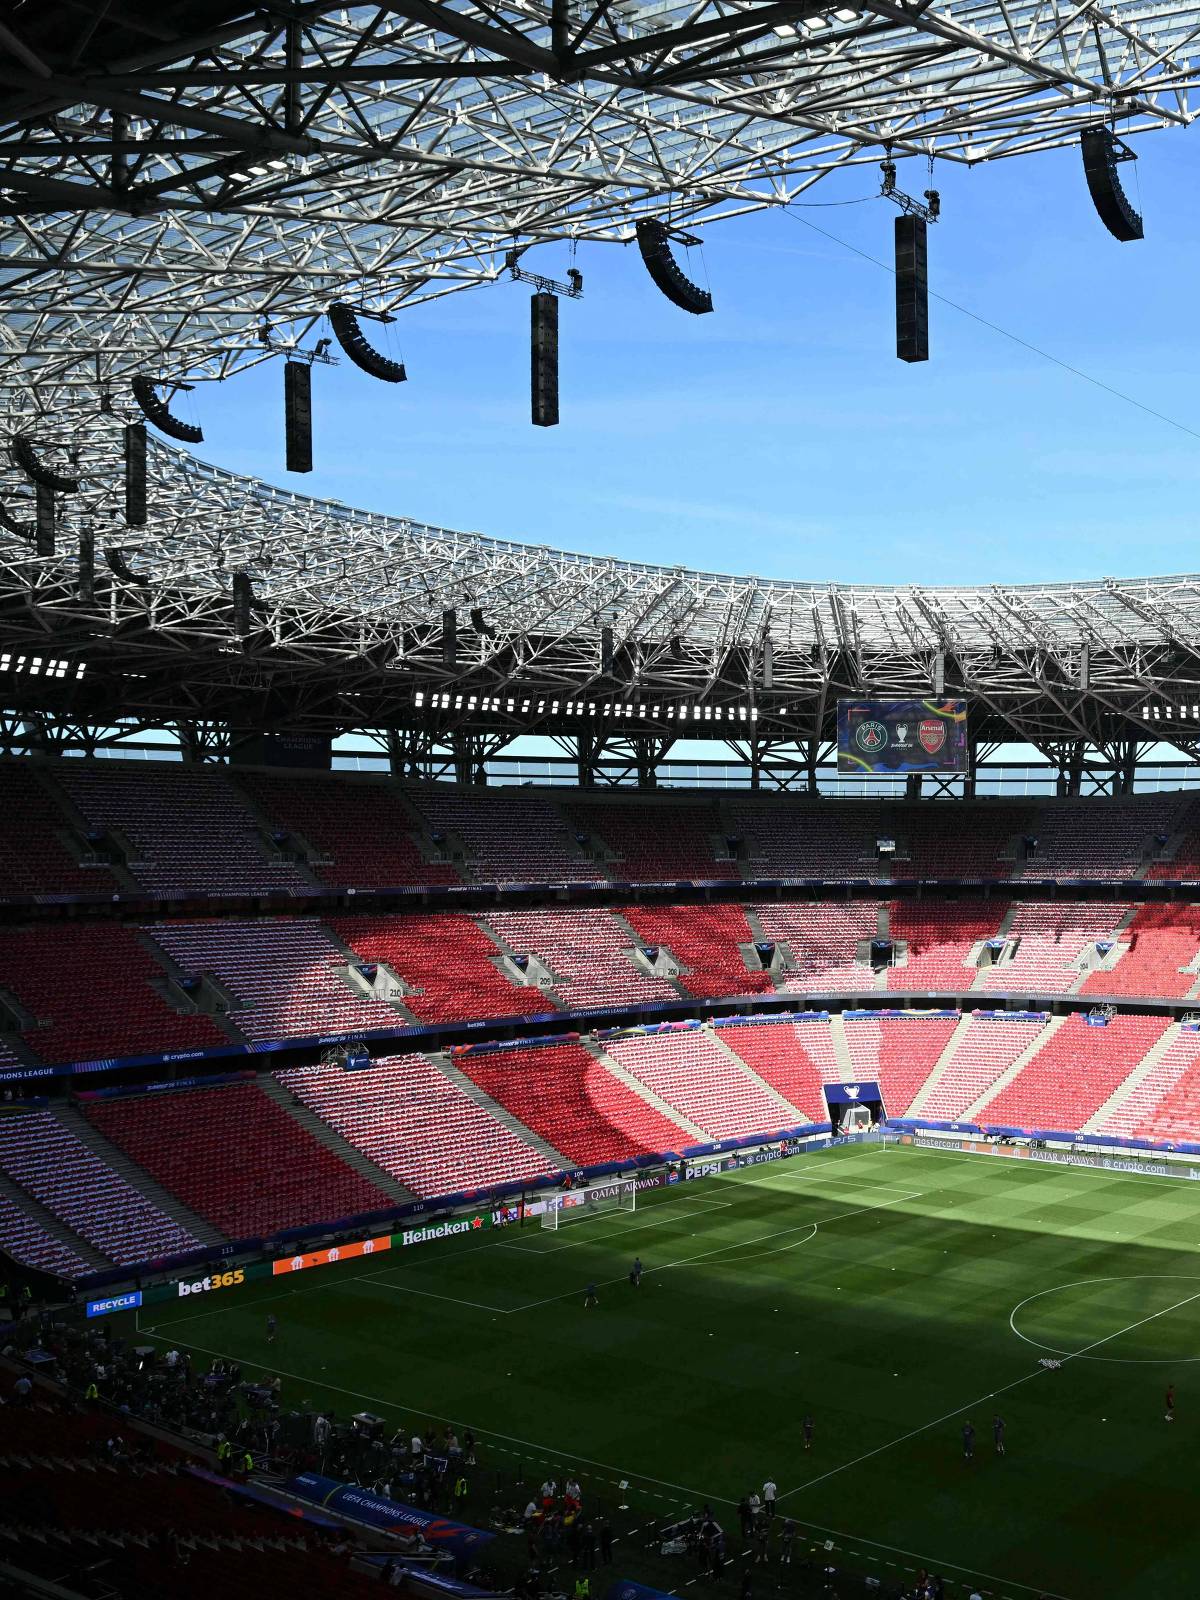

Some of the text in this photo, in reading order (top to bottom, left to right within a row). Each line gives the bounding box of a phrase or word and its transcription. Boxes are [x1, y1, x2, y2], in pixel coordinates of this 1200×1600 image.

[861, 722, 882, 731] PARIS
[540, 976, 551, 985] 209
[389, 988, 402, 998] 210
[171, 1051, 204, 1060] crypto.com
[24, 1068, 54, 1078] LEAGUE
[833, 1137, 856, 1148] PS5
[914, 1137, 960, 1149] mastercard
[1031, 1149, 1095, 1164] QATAR AIRWAYS
[685, 1163, 722, 1180] PEPSI
[1113, 1160, 1166, 1175] crypto.com
[624, 1177, 660, 1192] AIRWAYS
[413, 1204, 424, 1212] 110
[402, 1219, 470, 1245] Heineken
[221, 1246, 233, 1254] 111
[178, 1270, 245, 1296] bet365
[93, 1296, 136, 1312] RECYCLE
[343, 1492, 431, 1528] UEFA CHAMPIONS LEAGUE
